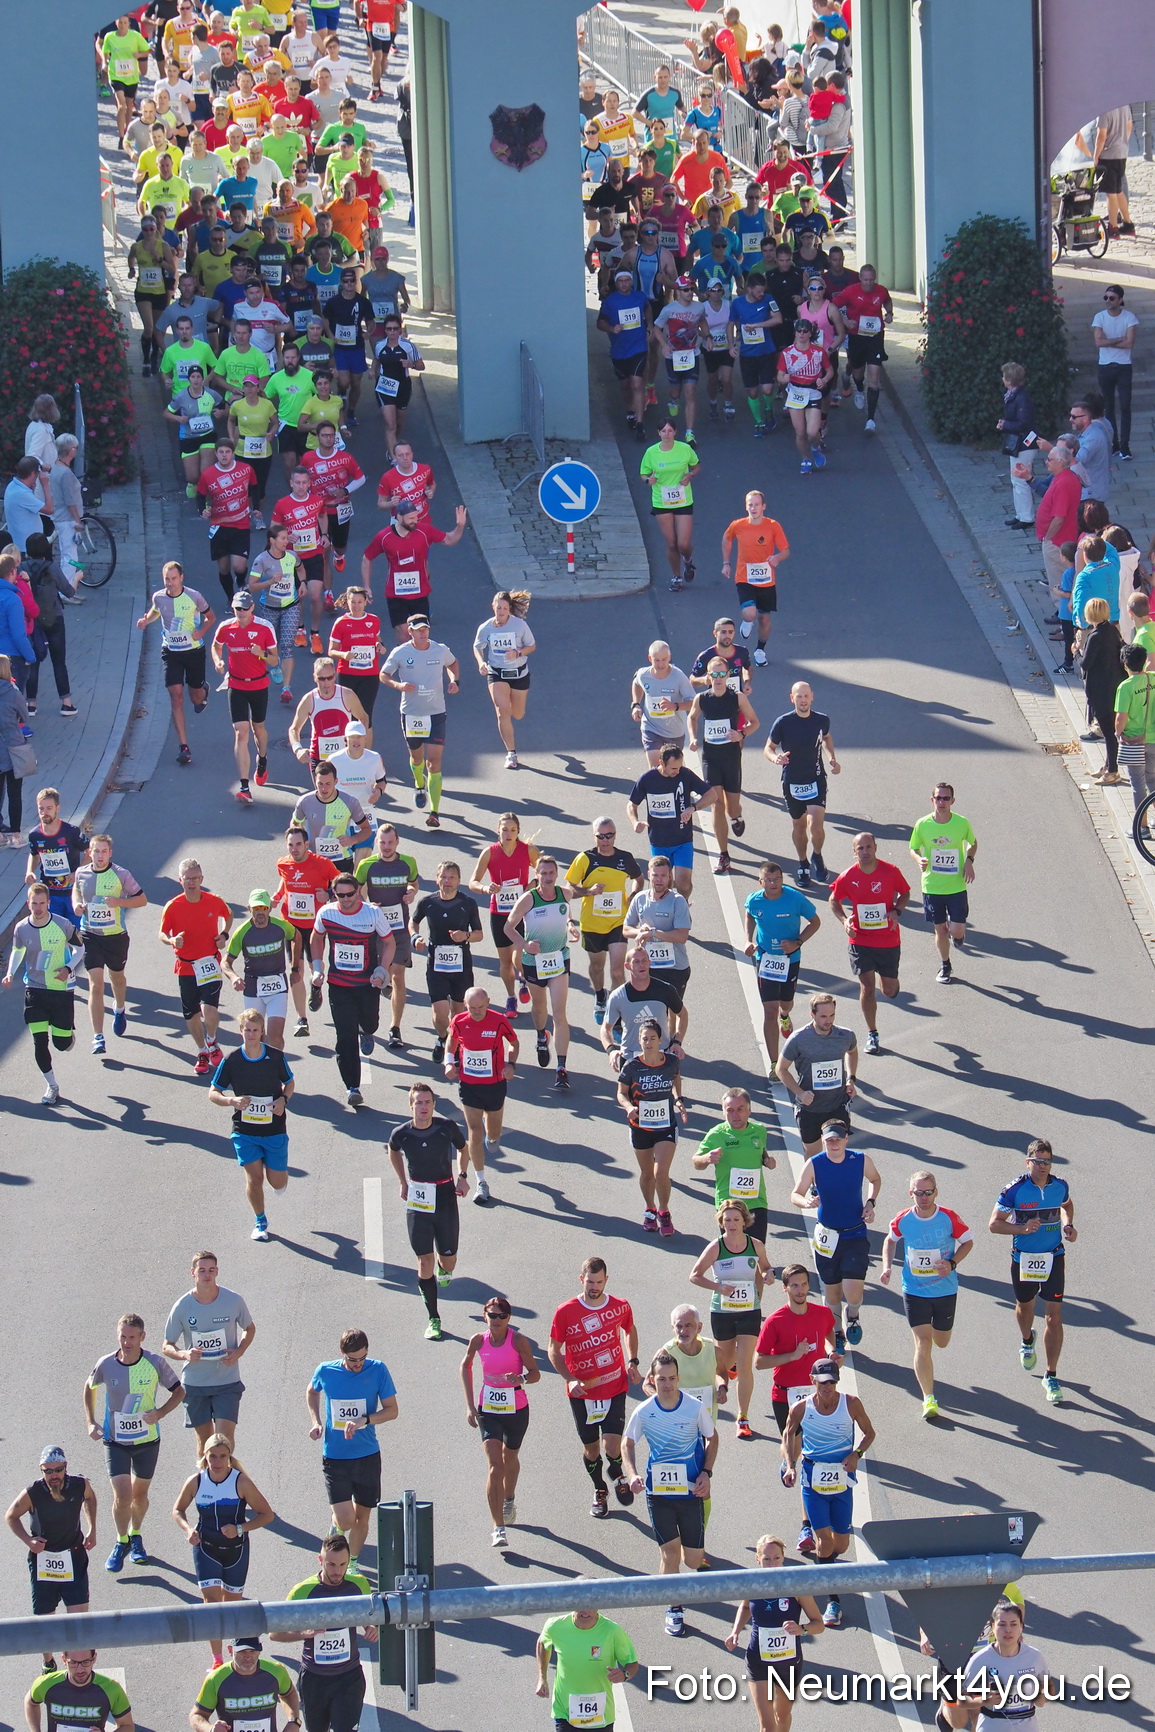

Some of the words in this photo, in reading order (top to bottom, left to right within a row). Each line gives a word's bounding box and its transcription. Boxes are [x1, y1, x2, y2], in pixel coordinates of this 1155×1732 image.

[624, 313, 637, 322] 319
[380, 378, 396, 388] 3062
[193, 422, 210, 430] 2235
[667, 491, 680, 499] 153
[750, 568, 768, 576] 2537
[398, 578, 416, 586] 2442
[169, 635, 188, 644] 3084
[493, 639, 512, 648] 2144
[354, 652, 372, 660] 2304
[413, 720, 423, 728] 28
[707, 726, 727, 735] 2160
[324, 743, 340, 751] 270
[651, 800, 671, 809] 2392
[319, 844, 340, 852] 2232
[44, 858, 64, 867] 3064
[935, 855, 956, 864] 2172
[370, 876, 408, 885] BOCK
[499, 892, 520, 902] 2441
[296, 900, 307, 909] 80
[602, 898, 614, 907] 86
[91, 909, 112, 919] 2234
[864, 910, 880, 920] 253
[246, 940, 283, 954] BOCK
[338, 951, 360, 961] 2519
[438, 953, 459, 962] 3057
[649, 949, 670, 958] 2131
[200, 963, 216, 974] 158
[542, 959, 557, 969] 241
[764, 959, 786, 971] 2308
[261, 982, 282, 992] 2526
[466, 1056, 488, 1067] 2335
[638, 1074, 663, 1083] HECK
[816, 1068, 838, 1079] 2597
[248, 1103, 266, 1114] 310
[643, 1107, 666, 1118] 2018
[737, 1176, 754, 1187] 228
[415, 1190, 426, 1200] 94
[918, 1257, 931, 1266] 73
[1027, 1260, 1046, 1270] 202
[197, 1338, 222, 1350] 2025
[489, 1390, 507, 1402] 206
[339, 1407, 359, 1418] 340
[119, 1419, 143, 1431] 3081
[660, 1471, 678, 1482] 211
[820, 1471, 839, 1482] 224
[45, 1558, 65, 1570] 309
[319, 1638, 346, 1651] 2524
[767, 1636, 787, 1648] 207
[224, 1692, 276, 1710] BOCK
[50, 1703, 102, 1718] BOCK
[577, 1702, 598, 1714] 164
